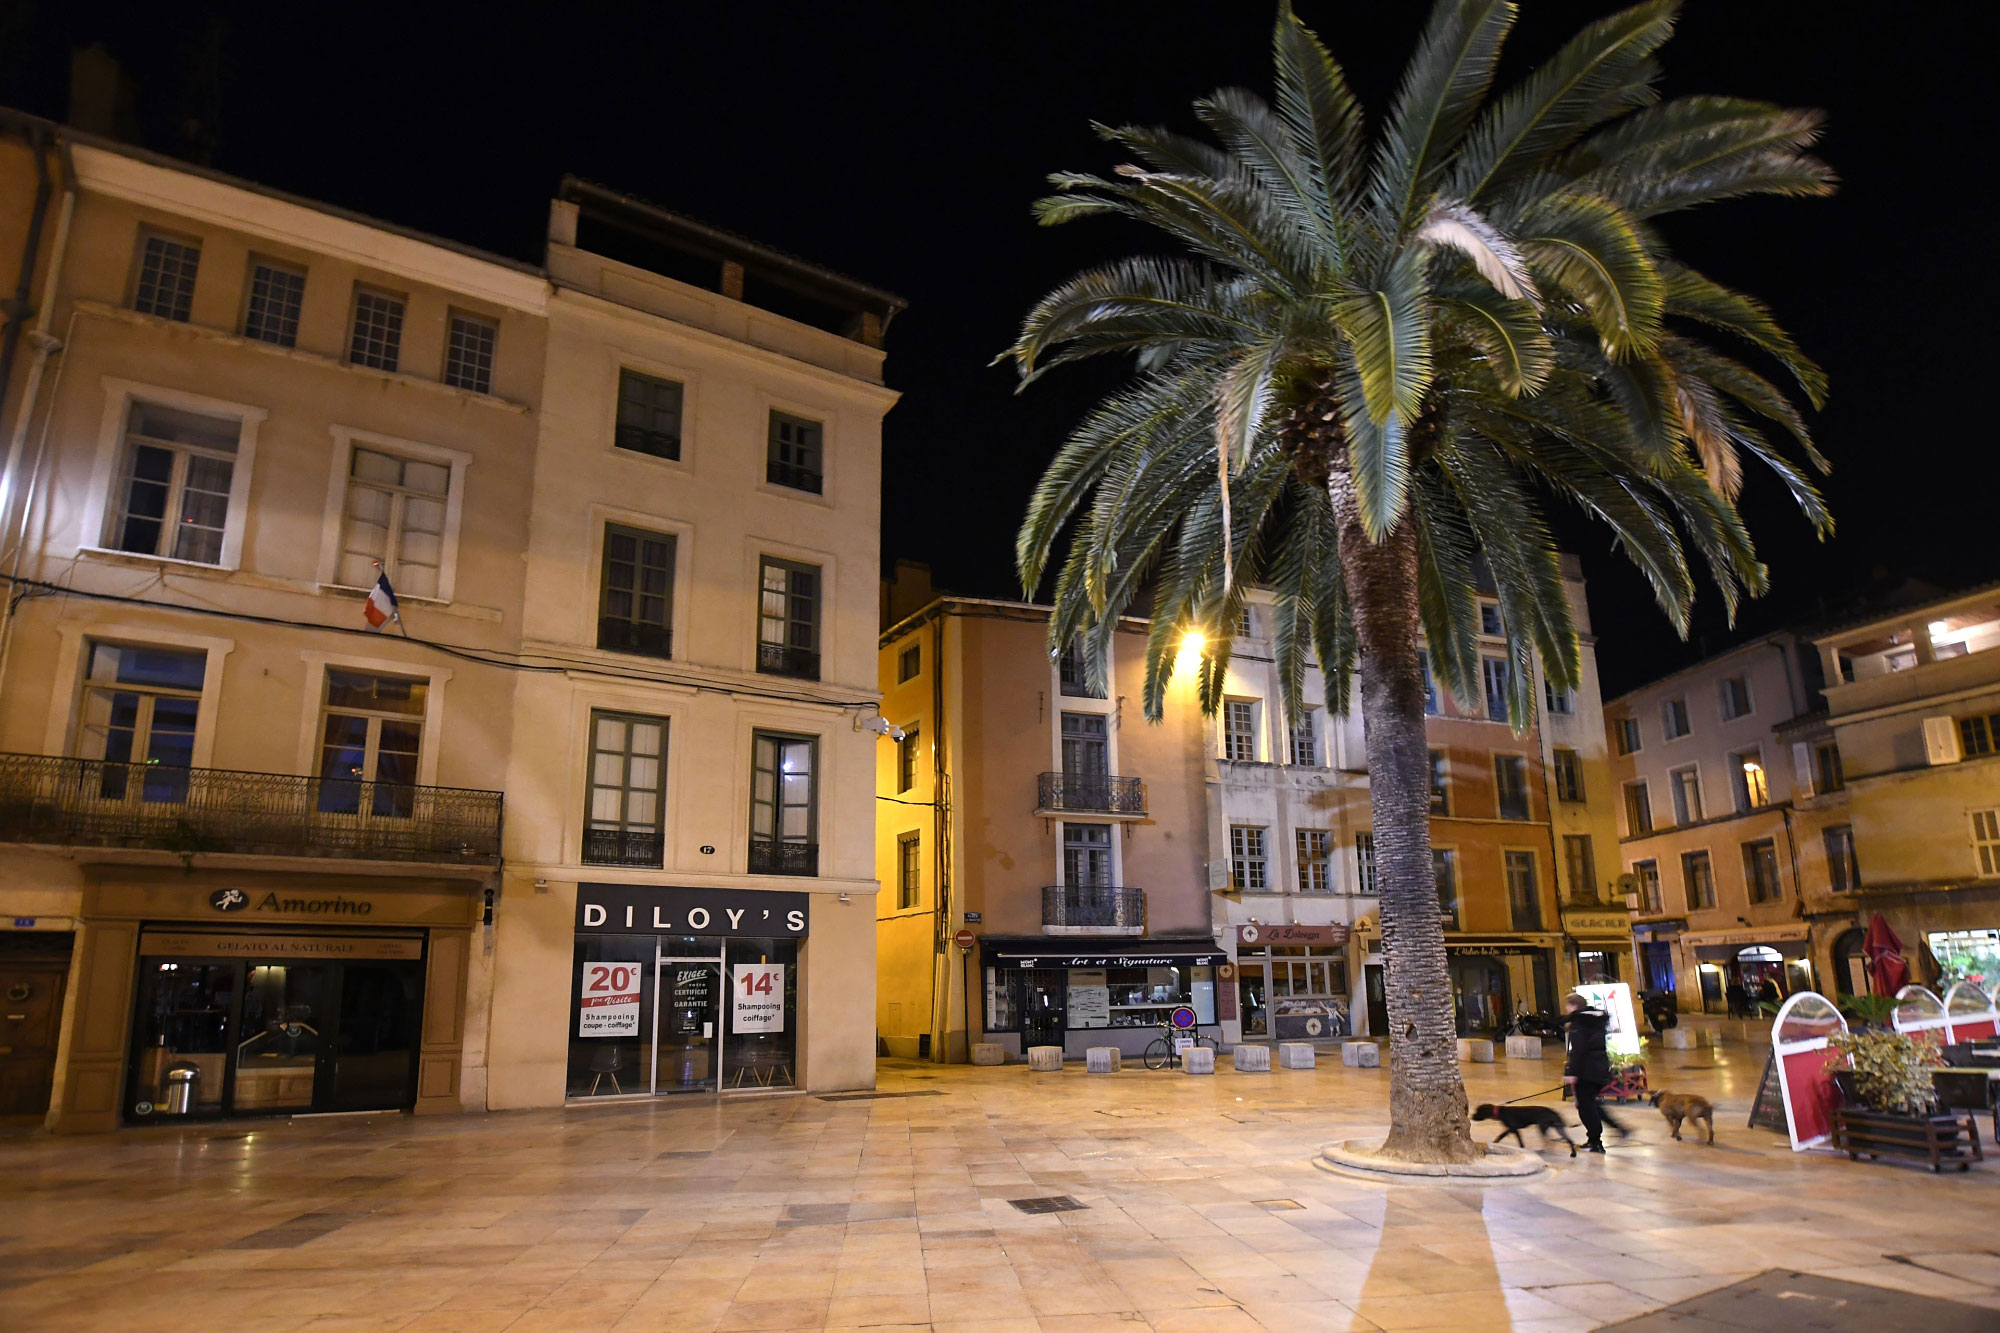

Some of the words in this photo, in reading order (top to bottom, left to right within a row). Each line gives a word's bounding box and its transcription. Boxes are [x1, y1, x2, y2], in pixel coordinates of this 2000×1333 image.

[256, 891, 372, 916] Amorino
[583, 903, 805, 931] DILOY'S
[217, 941, 269, 951] GELATO
[271, 943, 286, 951] AL
[290, 943, 355, 953] NATURALE
[1062, 957, 1089, 965] Art
[1113, 957, 1173, 968] Signature
[676, 969, 708, 982] EXIGEZ
[604, 995, 632, 1005] Visite
[737, 1003, 781, 1012] Shampooing
[585, 1013, 635, 1021] Shampooing
